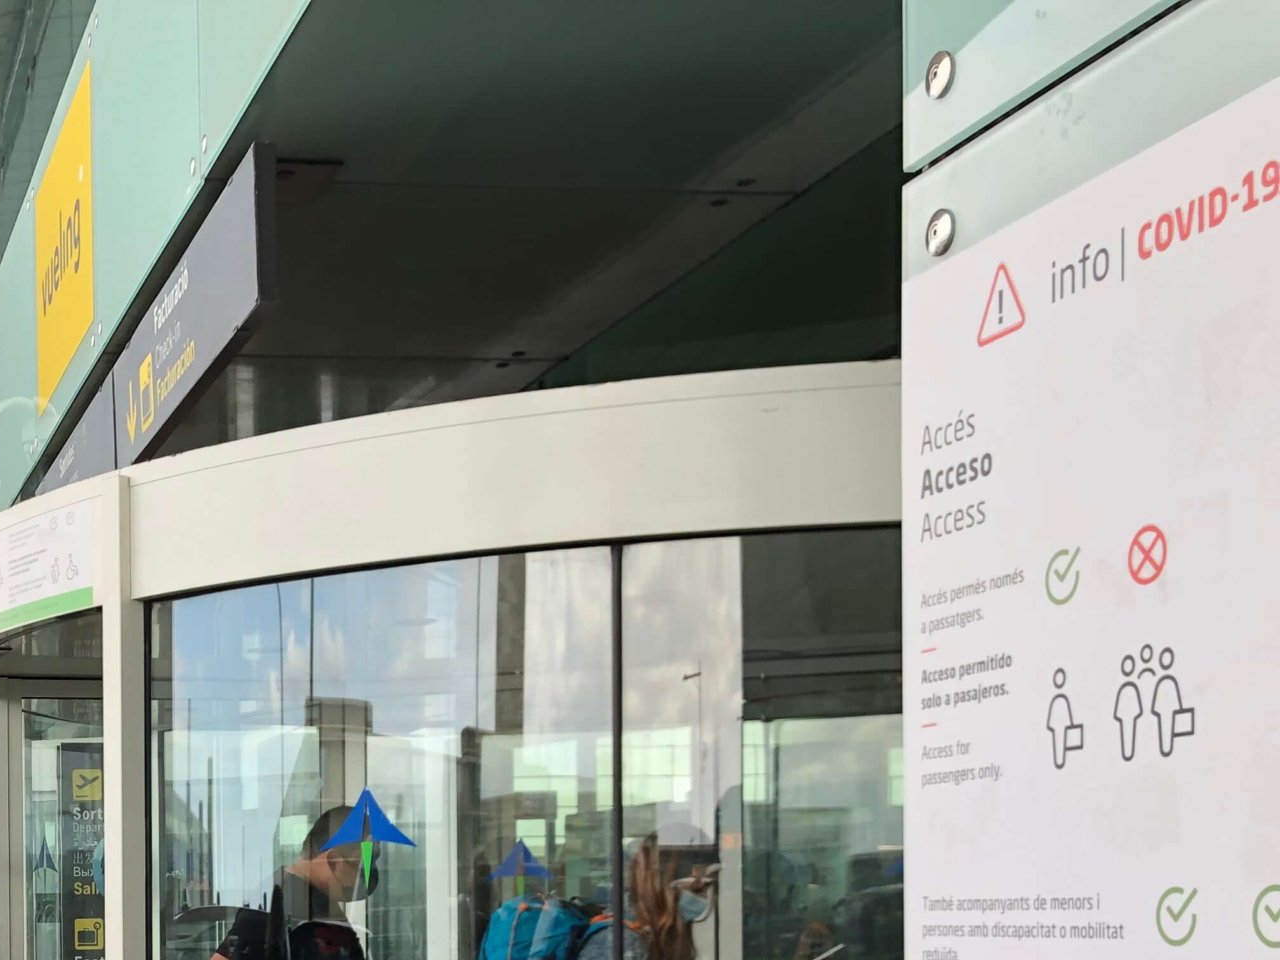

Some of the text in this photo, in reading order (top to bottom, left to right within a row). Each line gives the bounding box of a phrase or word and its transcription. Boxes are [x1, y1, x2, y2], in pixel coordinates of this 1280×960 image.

[1050, 159, 1280, 304] info COVID-19
[41, 197, 81, 317] vueling
[153, 260, 188, 335] Facturació
[157, 338, 195, 406] Facturación
[920, 409, 976, 455] Accés
[920, 453, 993, 499] Acceso
[920, 500, 987, 543] Access
[921, 588, 947, 609] Accés
[921, 620, 927, 634] a
[921, 653, 1012, 684] Acceso permitido
[921, 681, 1009, 711] solo a pasajeros.
[921, 740, 971, 761] Access for
[921, 762, 1002, 788] passengers only.
[922, 895, 954, 912] També
[956, 895, 1031, 915] acompanyants
[1033, 893, 1047, 911] de
[1050, 895, 1094, 911] menors
[922, 921, 1124, 942] persones amb discapacitat o mobilitat
